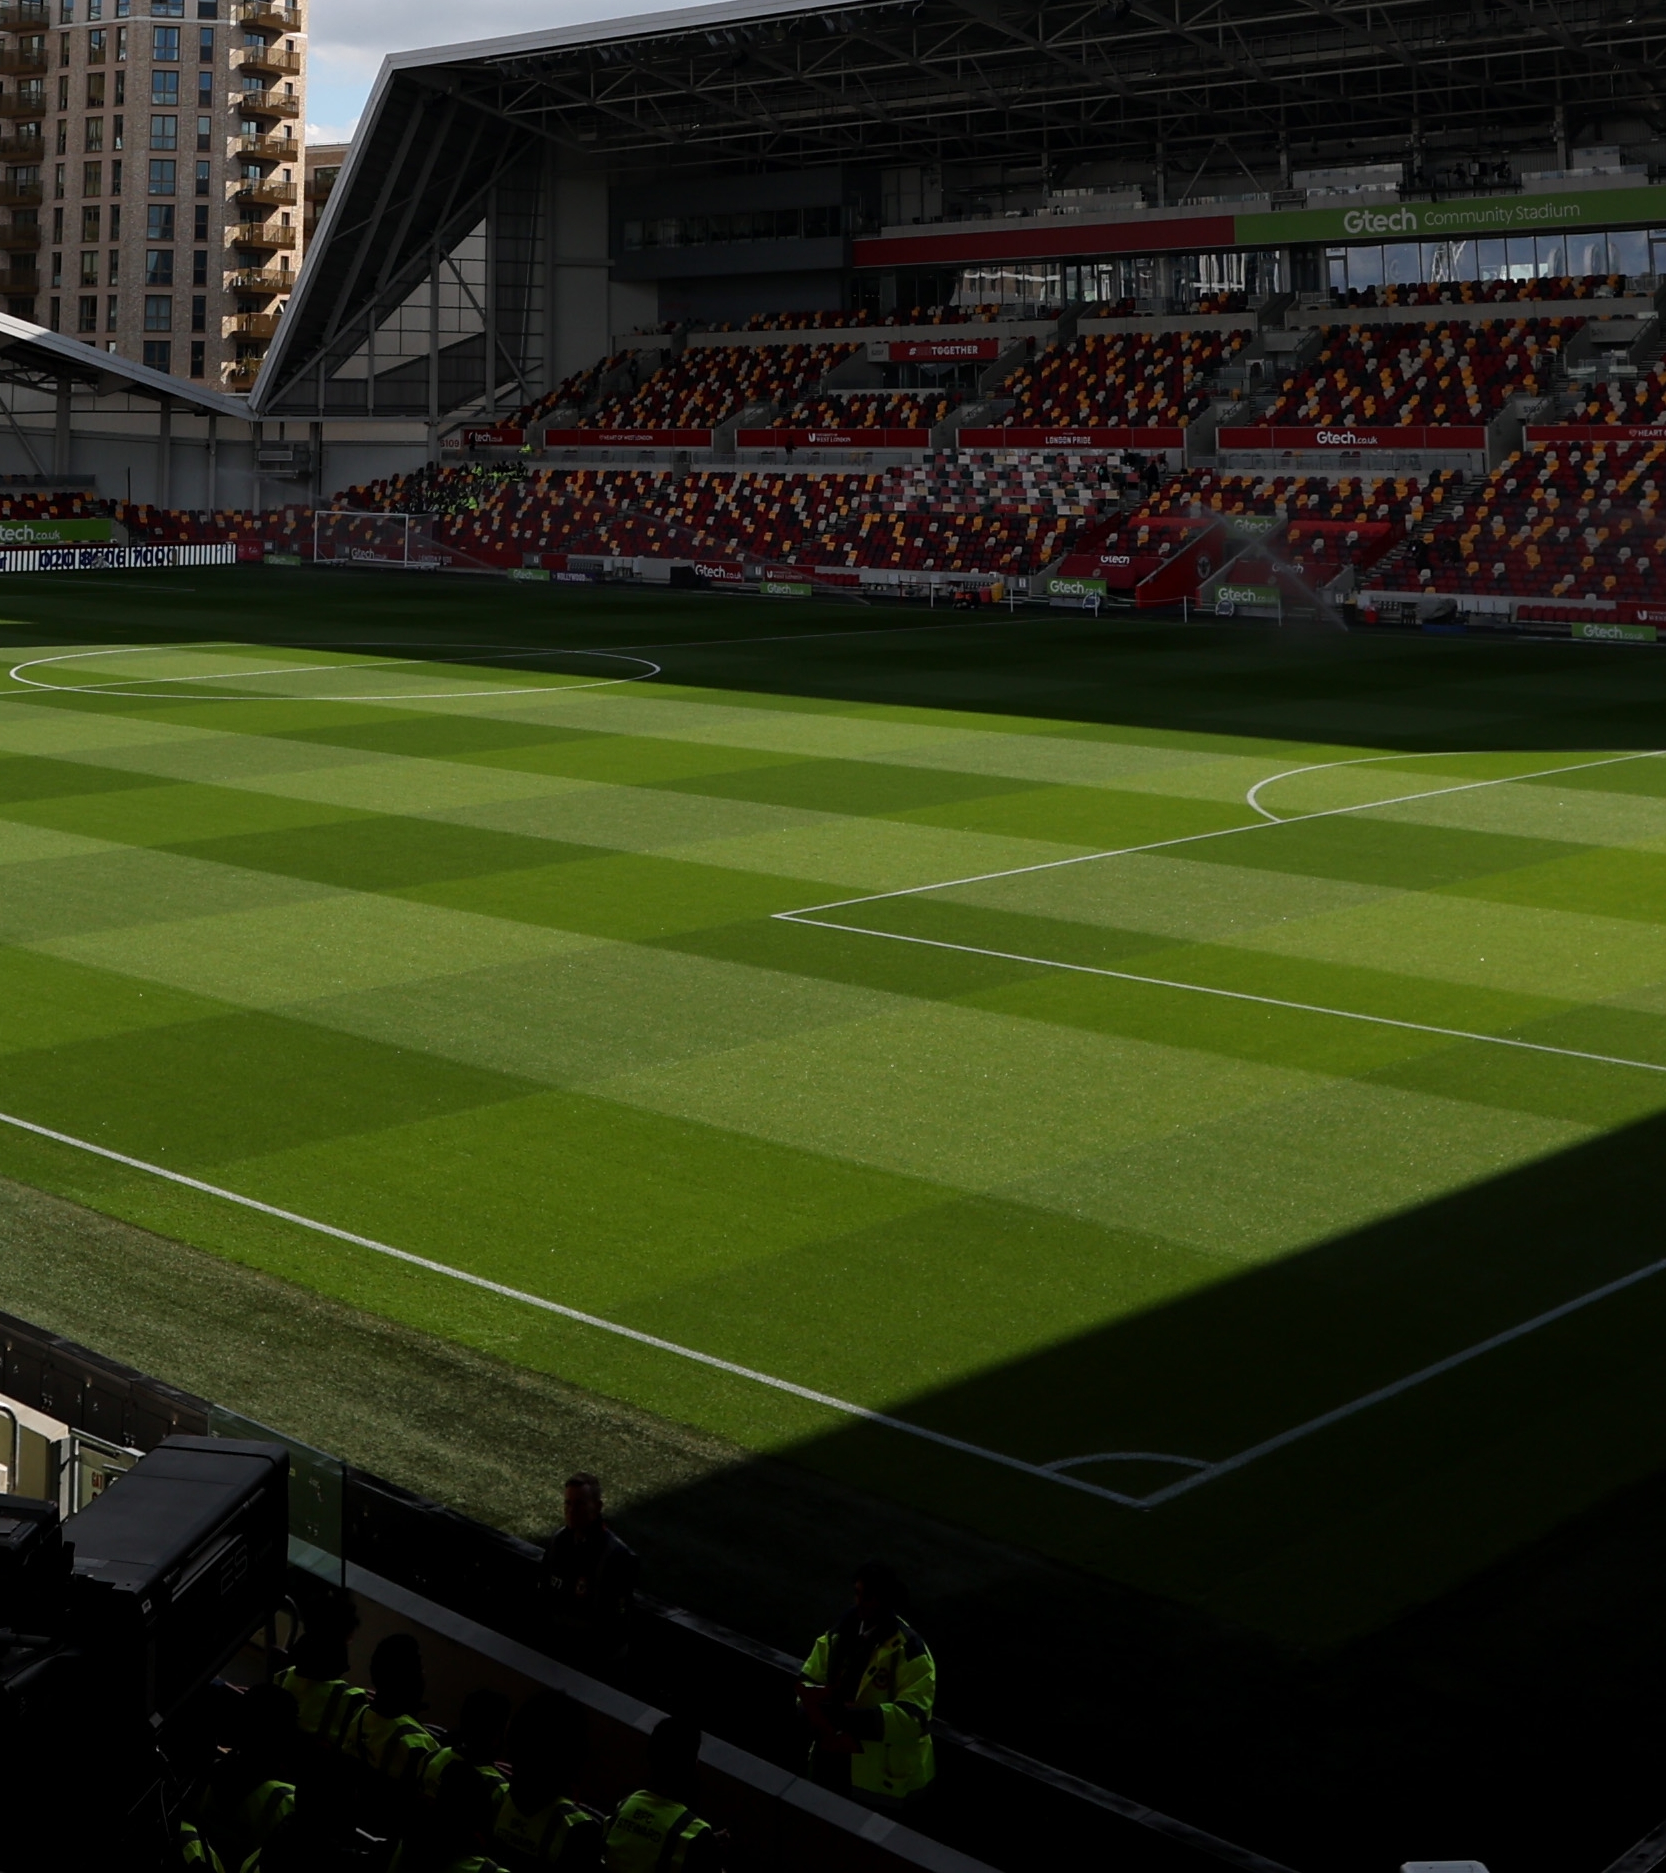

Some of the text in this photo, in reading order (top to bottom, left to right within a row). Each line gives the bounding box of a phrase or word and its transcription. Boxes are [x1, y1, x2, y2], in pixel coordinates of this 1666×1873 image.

[1343, 202, 1581, 233] Gtech Community Stadium
[1316, 430, 1379, 444] Gtech.co.uk
[1638, 429, 1663, 437] HEART
[439, 439, 460, 448] S109
[1045, 436, 1091, 444] LONDON PRIDE
[39, 548, 73, 568] 020
[1272, 562, 1304, 573] Gch
[1648, 614, 1666, 622] WEST
[1583, 624, 1645, 640] Gtech.co.uk
[633, 1807, 656, 1825] BFC
